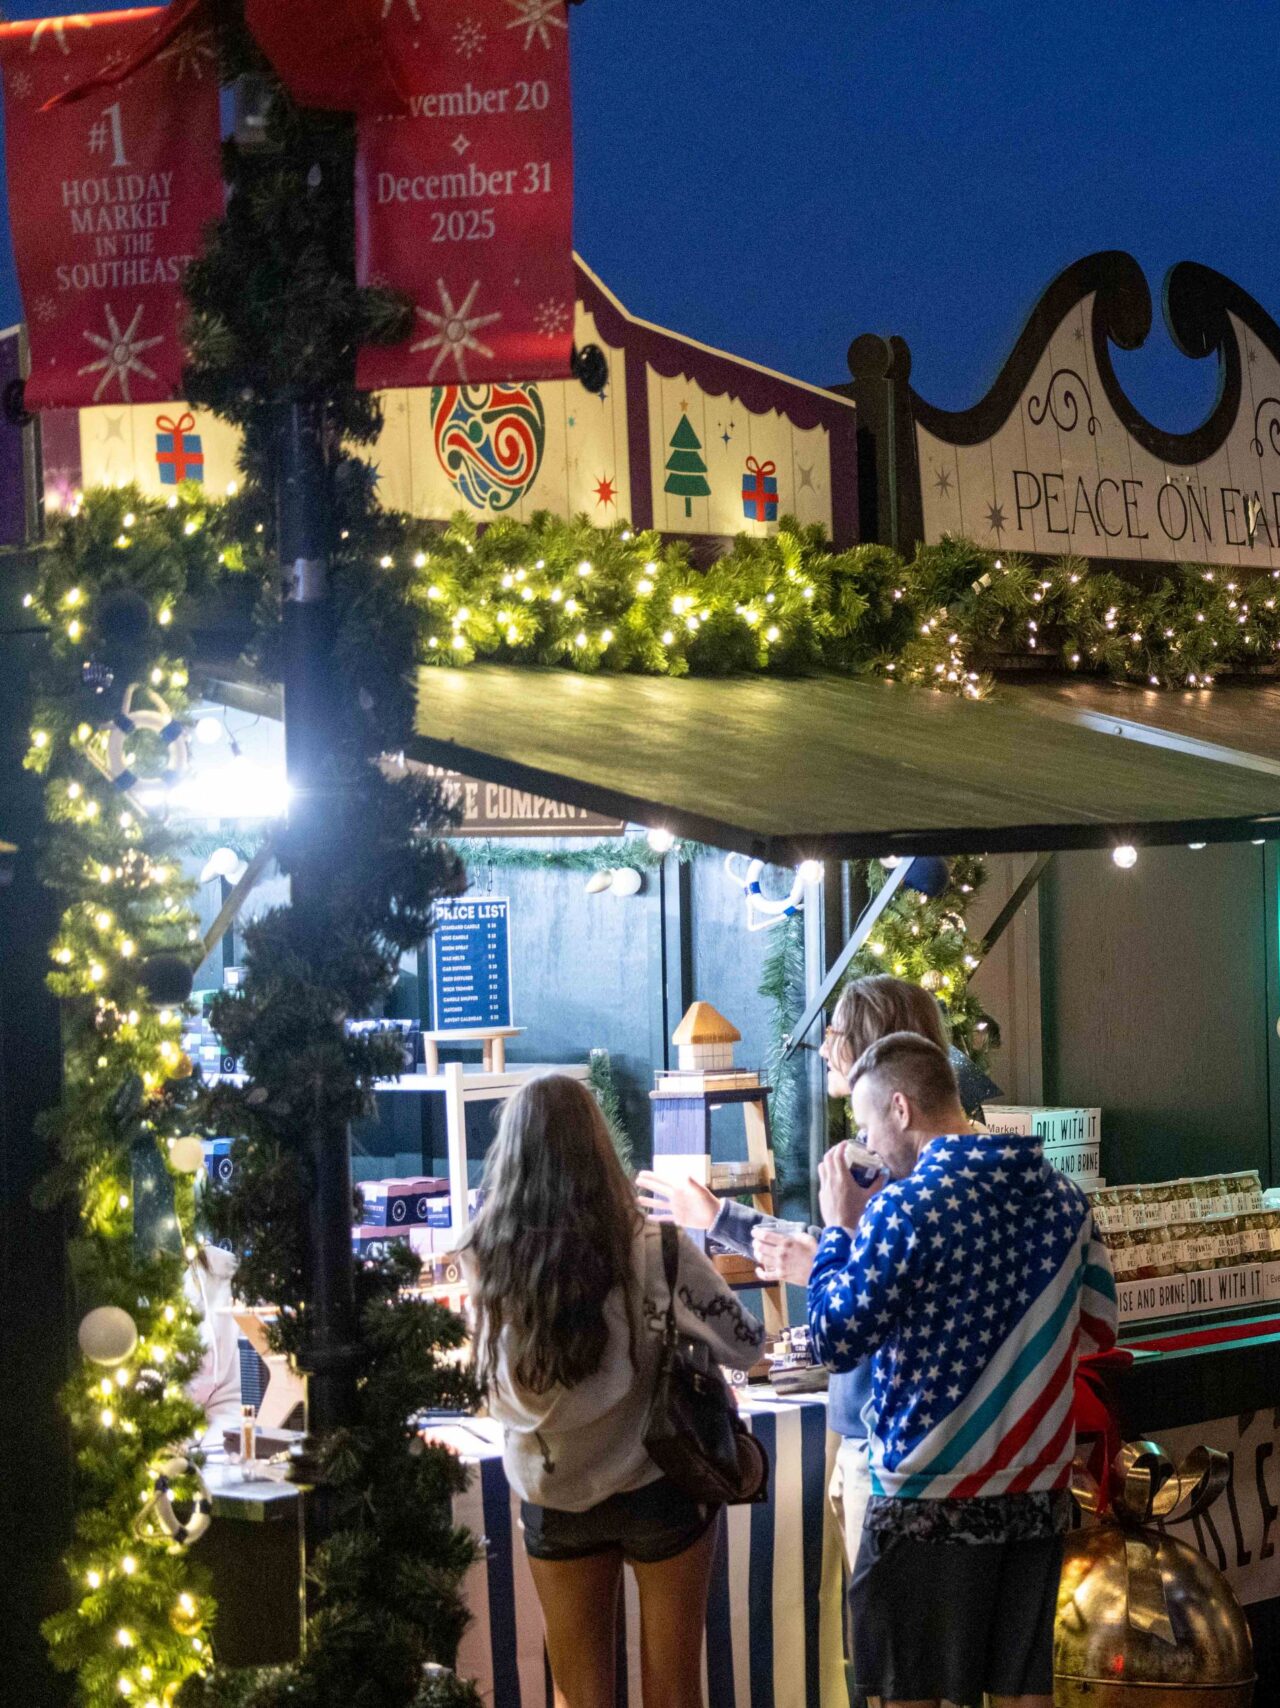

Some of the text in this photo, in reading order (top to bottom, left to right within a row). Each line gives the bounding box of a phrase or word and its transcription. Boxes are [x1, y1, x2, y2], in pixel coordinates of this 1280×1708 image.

[377, 80, 549, 121] vember 20
[88, 102, 131, 167] #1
[61, 170, 173, 207] HOLIDAY
[378, 162, 552, 203] December 31
[71, 200, 171, 234] MARKET
[431, 208, 496, 242] 2025
[96, 233, 155, 256] IN THE
[1012, 470, 1149, 539] PEACE
[1157, 483, 1212, 544] ON
[436, 904, 506, 920] PRICE LIST
[988, 1124, 1018, 1135] Market
[1060, 1117, 1084, 1141] WITH
[1088, 1116, 1097, 1138] IT
[1061, 1154, 1075, 1174] AND
[1119, 1290, 1133, 1313] ISE
[1138, 1288, 1156, 1310] AND
[1219, 1272, 1246, 1300] WITH
[1251, 1270, 1261, 1296] IT
